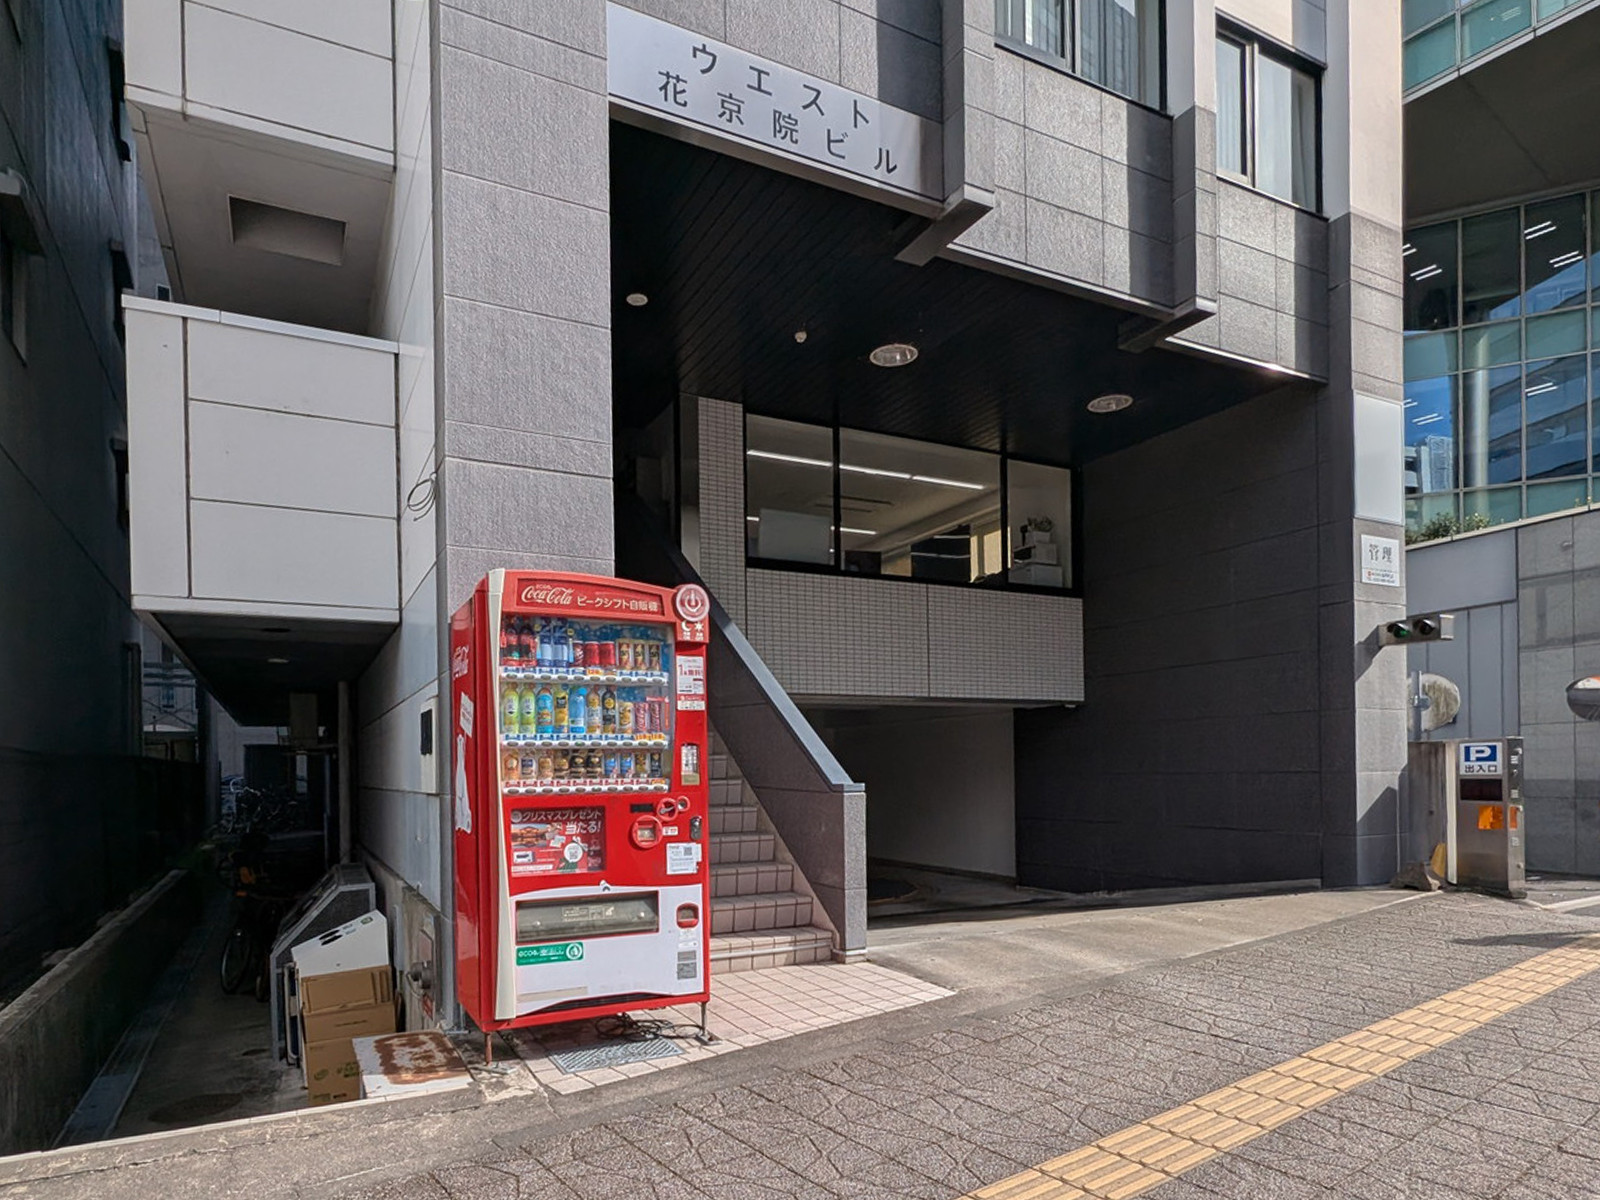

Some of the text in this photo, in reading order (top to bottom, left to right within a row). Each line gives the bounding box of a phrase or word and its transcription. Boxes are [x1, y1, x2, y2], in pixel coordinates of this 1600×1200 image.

[691, 43, 870, 129] ウエスト
[657, 70, 898, 175] 花京院ビル
[1469, 746, 1492, 761] P
[1464, 764, 1498, 774] 出入口
[522, 807, 602, 821] クリスマスプレゼント
[565, 820, 602, 835] 当たる!
